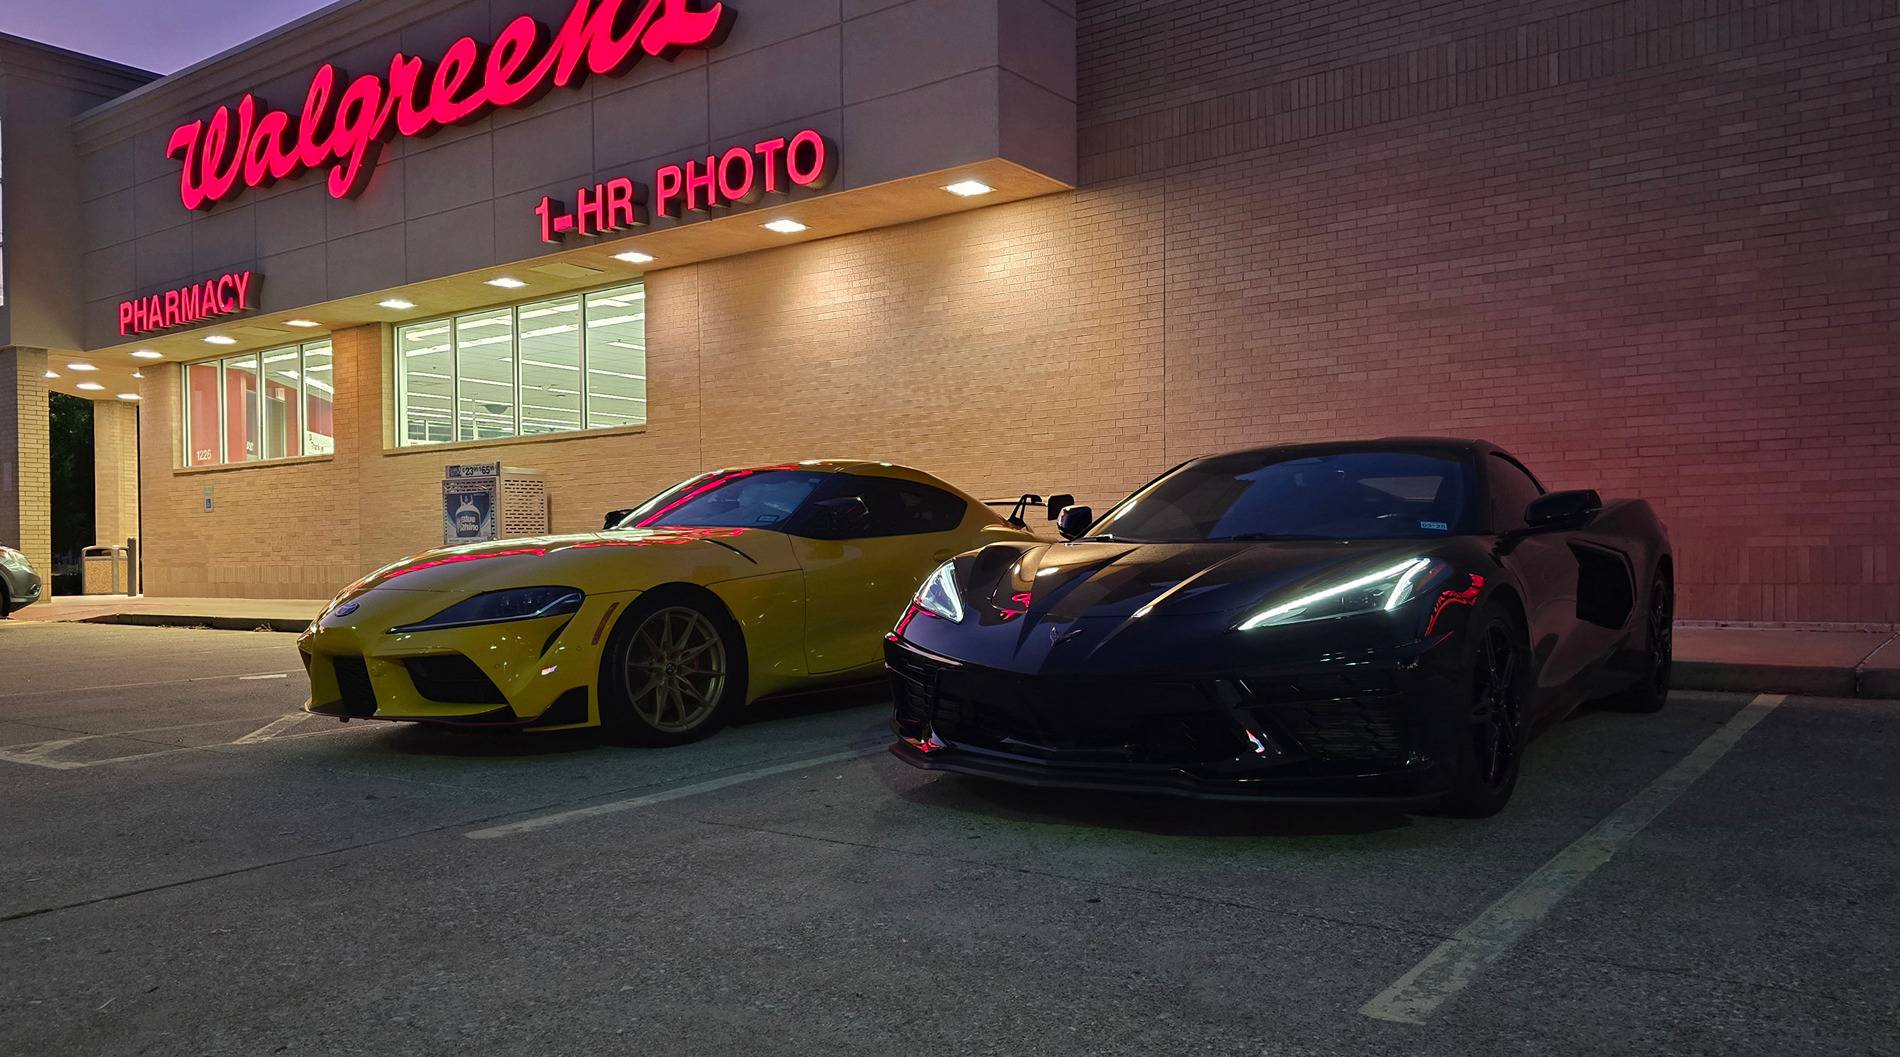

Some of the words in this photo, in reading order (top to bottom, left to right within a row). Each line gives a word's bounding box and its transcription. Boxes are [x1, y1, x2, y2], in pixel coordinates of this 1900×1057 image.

[167, 0, 723, 211] Walgreens
[535, 176, 635, 243] 1-HR
[656, 129, 825, 217] PHOTO
[120, 271, 250, 336] PHARMACY
